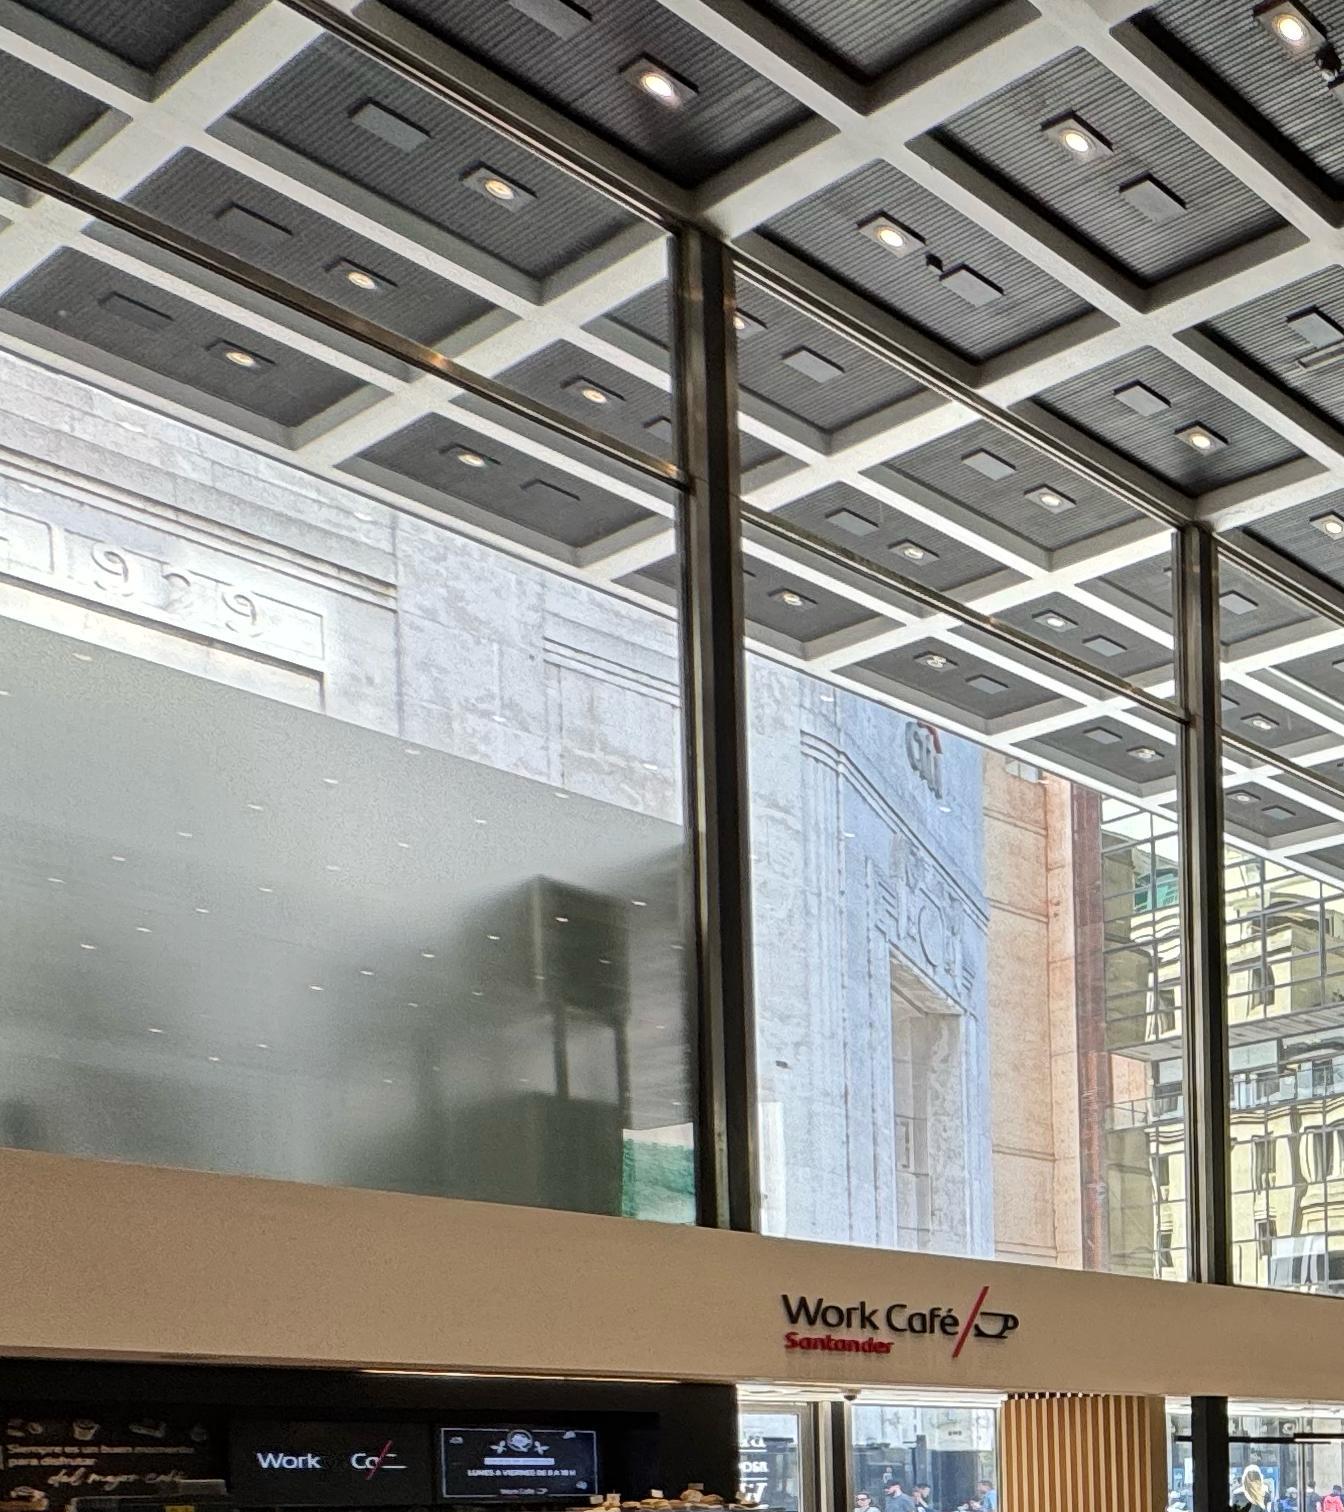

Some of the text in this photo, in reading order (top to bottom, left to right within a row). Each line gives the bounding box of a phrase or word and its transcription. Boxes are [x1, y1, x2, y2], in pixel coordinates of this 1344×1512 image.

[781, 1294, 960, 1337] Work Café
[784, 1331, 895, 1355] Santander
[256, 1453, 322, 1469] Work
